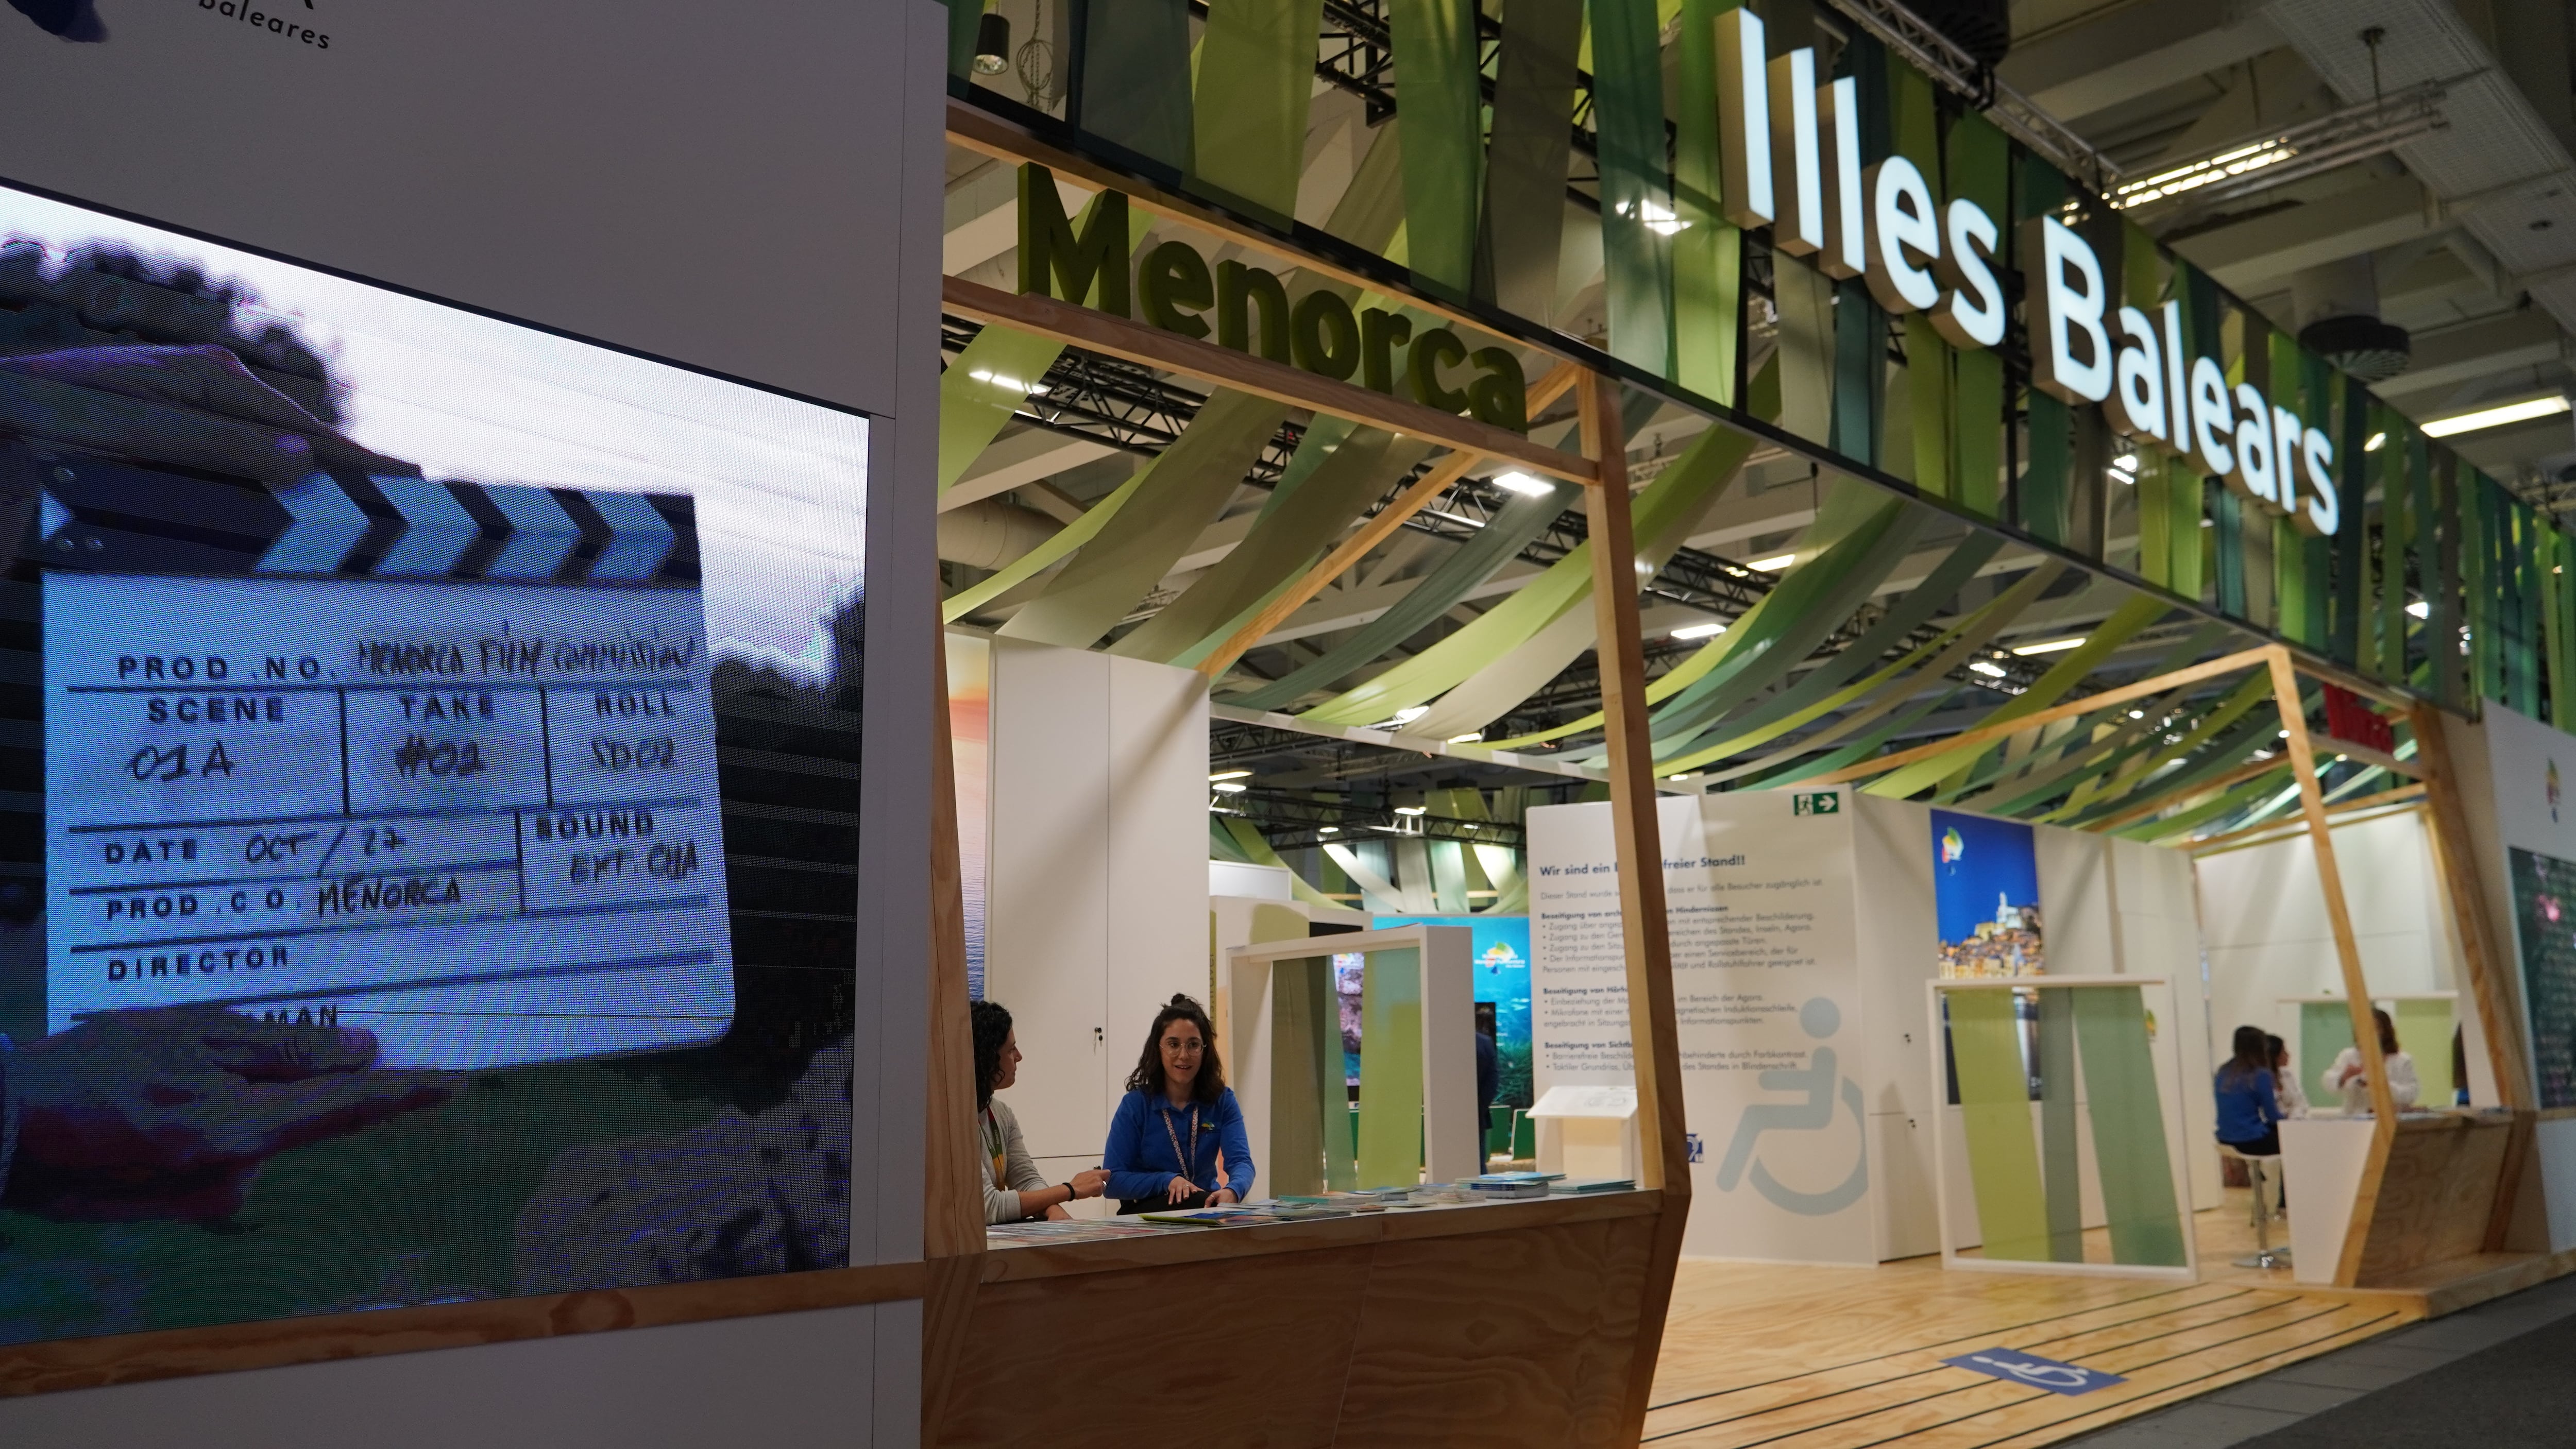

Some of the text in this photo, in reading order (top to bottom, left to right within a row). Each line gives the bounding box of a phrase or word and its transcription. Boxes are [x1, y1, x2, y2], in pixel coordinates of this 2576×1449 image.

[1737, 7, 2339, 536] Illes Balears
[1017, 161, 1528, 440] Menorca
[147, 697, 284, 723] SCENE
[399, 694, 494, 721] TAKE
[595, 694, 675, 718] ROLL
[537, 810, 654, 842] SOUND
[104, 838, 197, 864] DATE
[1539, 855, 1745, 876] Wir sind ein freier Stand!!
[317, 876, 462, 917] MENORCA
[1540, 892, 1564, 900] Dieser
[1566, 890, 1588, 899] Stand
[1589, 890, 1613, 898] wurde
[1727, 882, 1763, 891] Besucher
[1541, 912, 1586, 920] Beseitigung
[1549, 923, 1578, 931] Zugang
[1549, 933, 1578, 942] Zugang
[1549, 944, 1578, 953] Zugang
[107, 945, 289, 981] DIRECTOR
[1542, 965, 1576, 974] Personen
[1543, 987, 1587, 996] Beseitigung
[1689, 994, 1719, 1002] Bereich
[1545, 1042, 1589, 1050] Beseitigung
[1698, 1062, 1730, 1070] Standes
